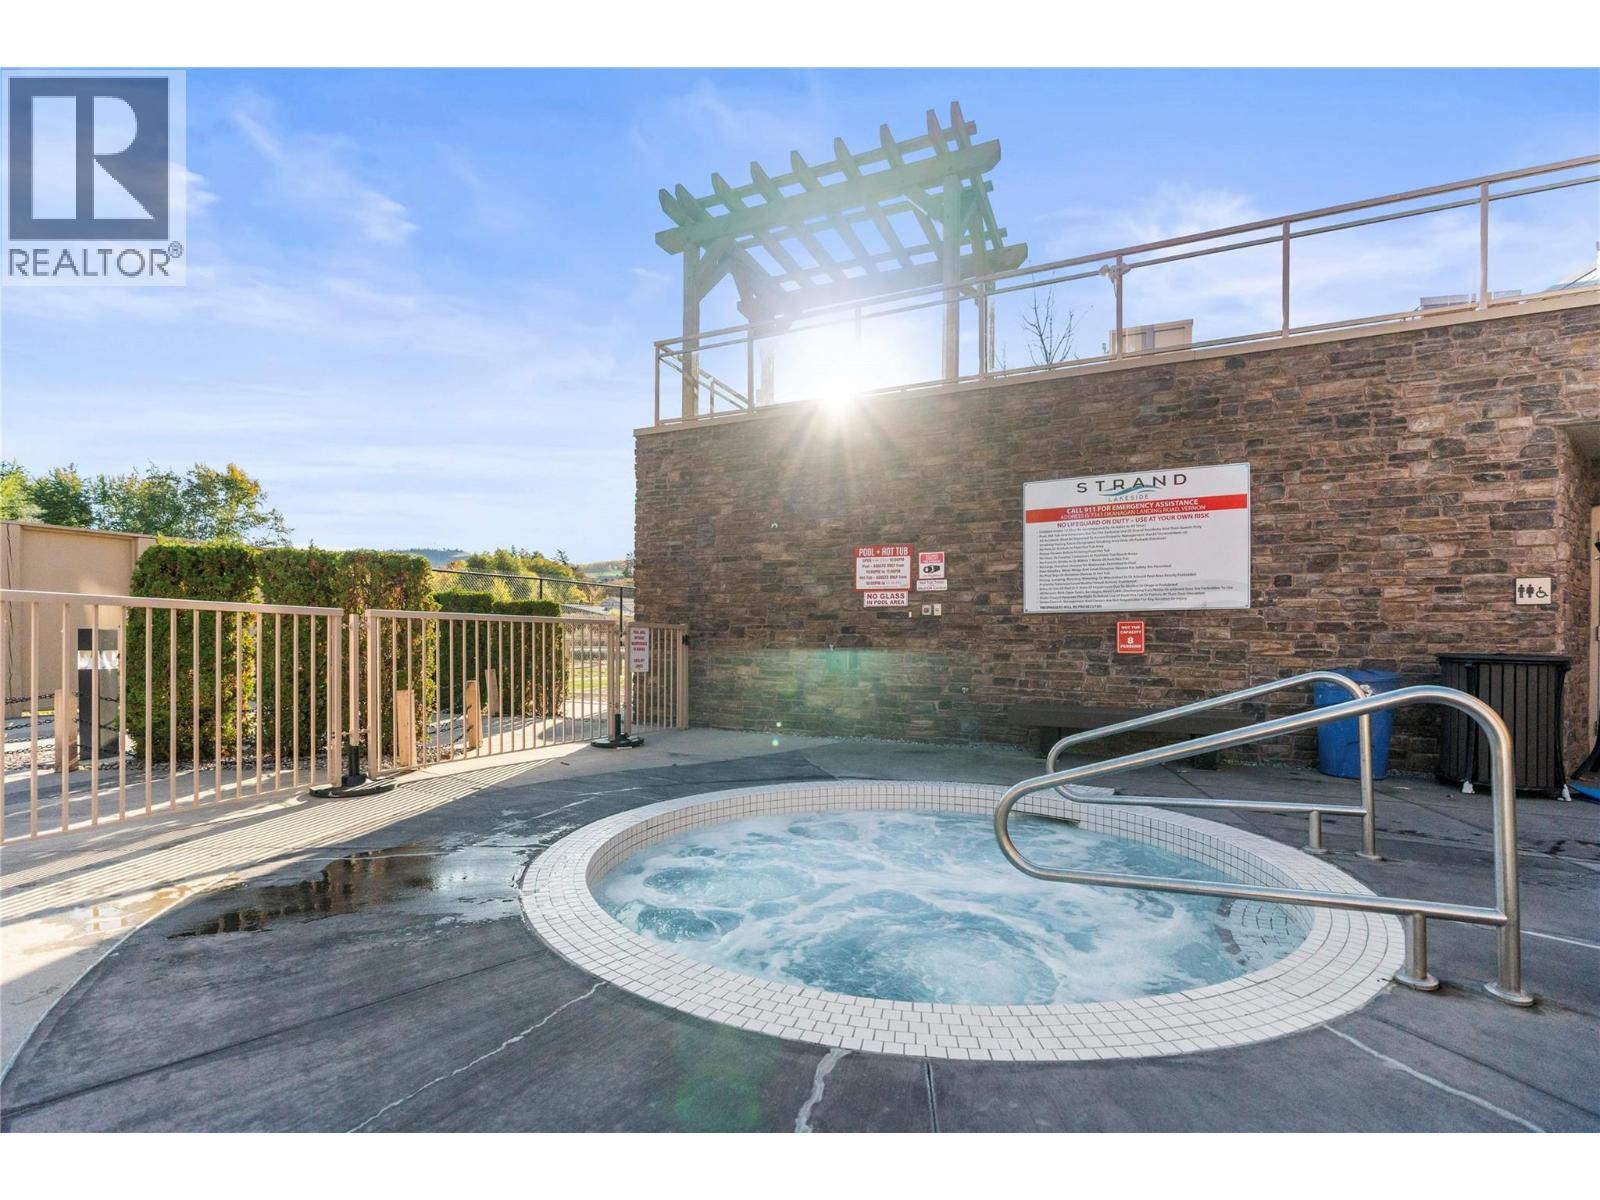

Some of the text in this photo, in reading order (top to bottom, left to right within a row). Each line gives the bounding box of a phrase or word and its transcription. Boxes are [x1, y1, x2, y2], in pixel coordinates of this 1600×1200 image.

[1077, 474, 1187, 493] STRAND
[1108, 494, 1149, 502] LAKESIDE
[1112, 501, 1156, 511] EMERGENCY
[1156, 499, 1199, 508] ASSISTANCE
[1104, 509, 1136, 517] OKANAGAN
[858, 548, 874, 556] POOL
[882, 548, 894, 556] HOT
[896, 546, 908, 555] TUB
